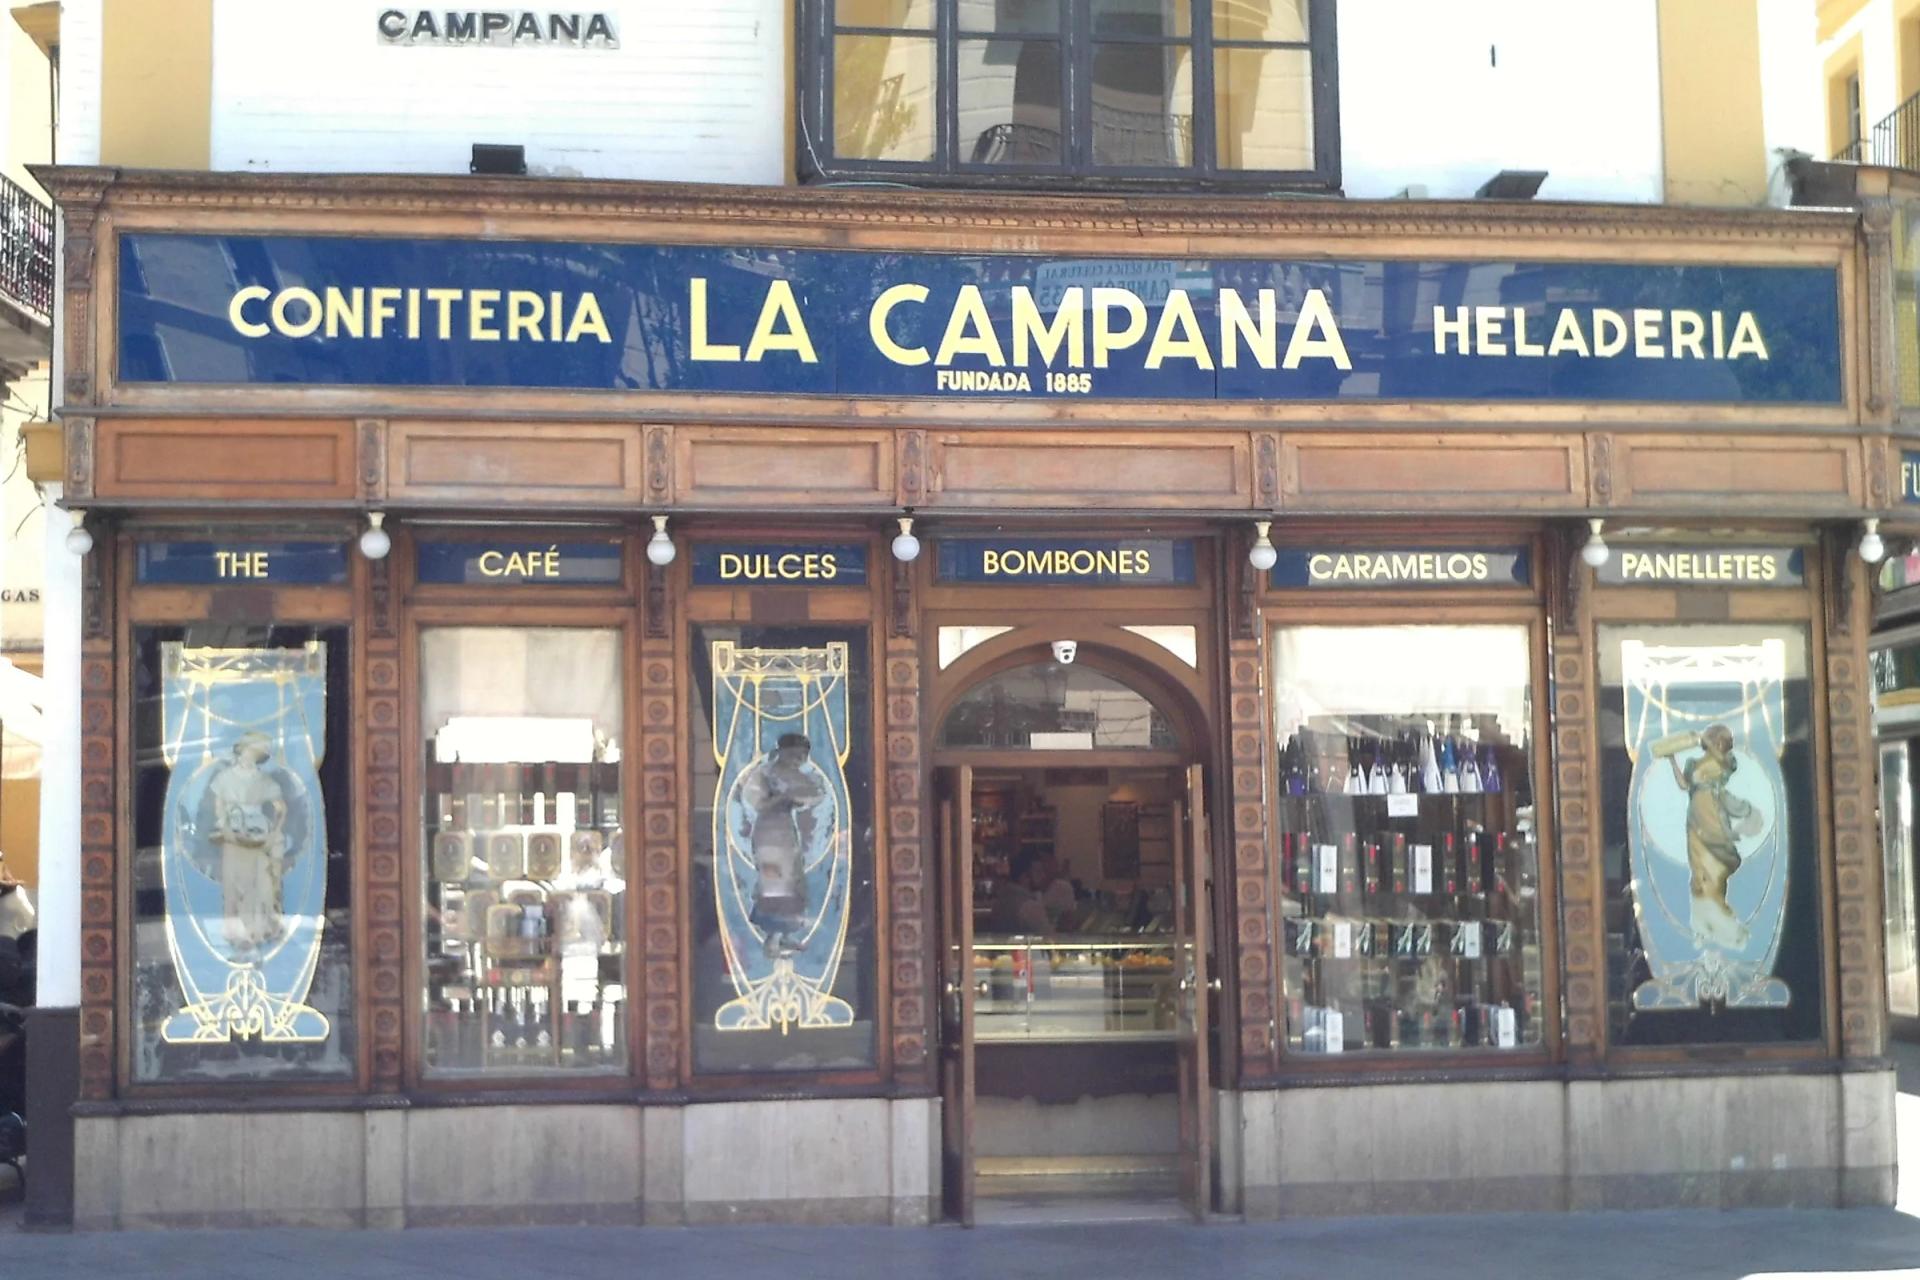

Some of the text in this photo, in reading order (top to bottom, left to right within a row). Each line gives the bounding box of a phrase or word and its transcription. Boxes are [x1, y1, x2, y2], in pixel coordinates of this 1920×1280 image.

[378, 10, 614, 43] CAMPANA
[228, 285, 612, 344] CONFITERIA
[689, 277, 1353, 371] LA CAMPANA
[1433, 304, 1770, 361] HELADERIA
[936, 370, 1092, 393] FUNDADA 1885
[215, 551, 269, 578] THE
[478, 544, 560, 577] CAFÉ
[719, 553, 838, 579] DULCES
[983, 549, 1151, 575] BOMBONES
[1308, 552, 1489, 581] CARAMELOS
[1621, 552, 1777, 581] PANELLETES
